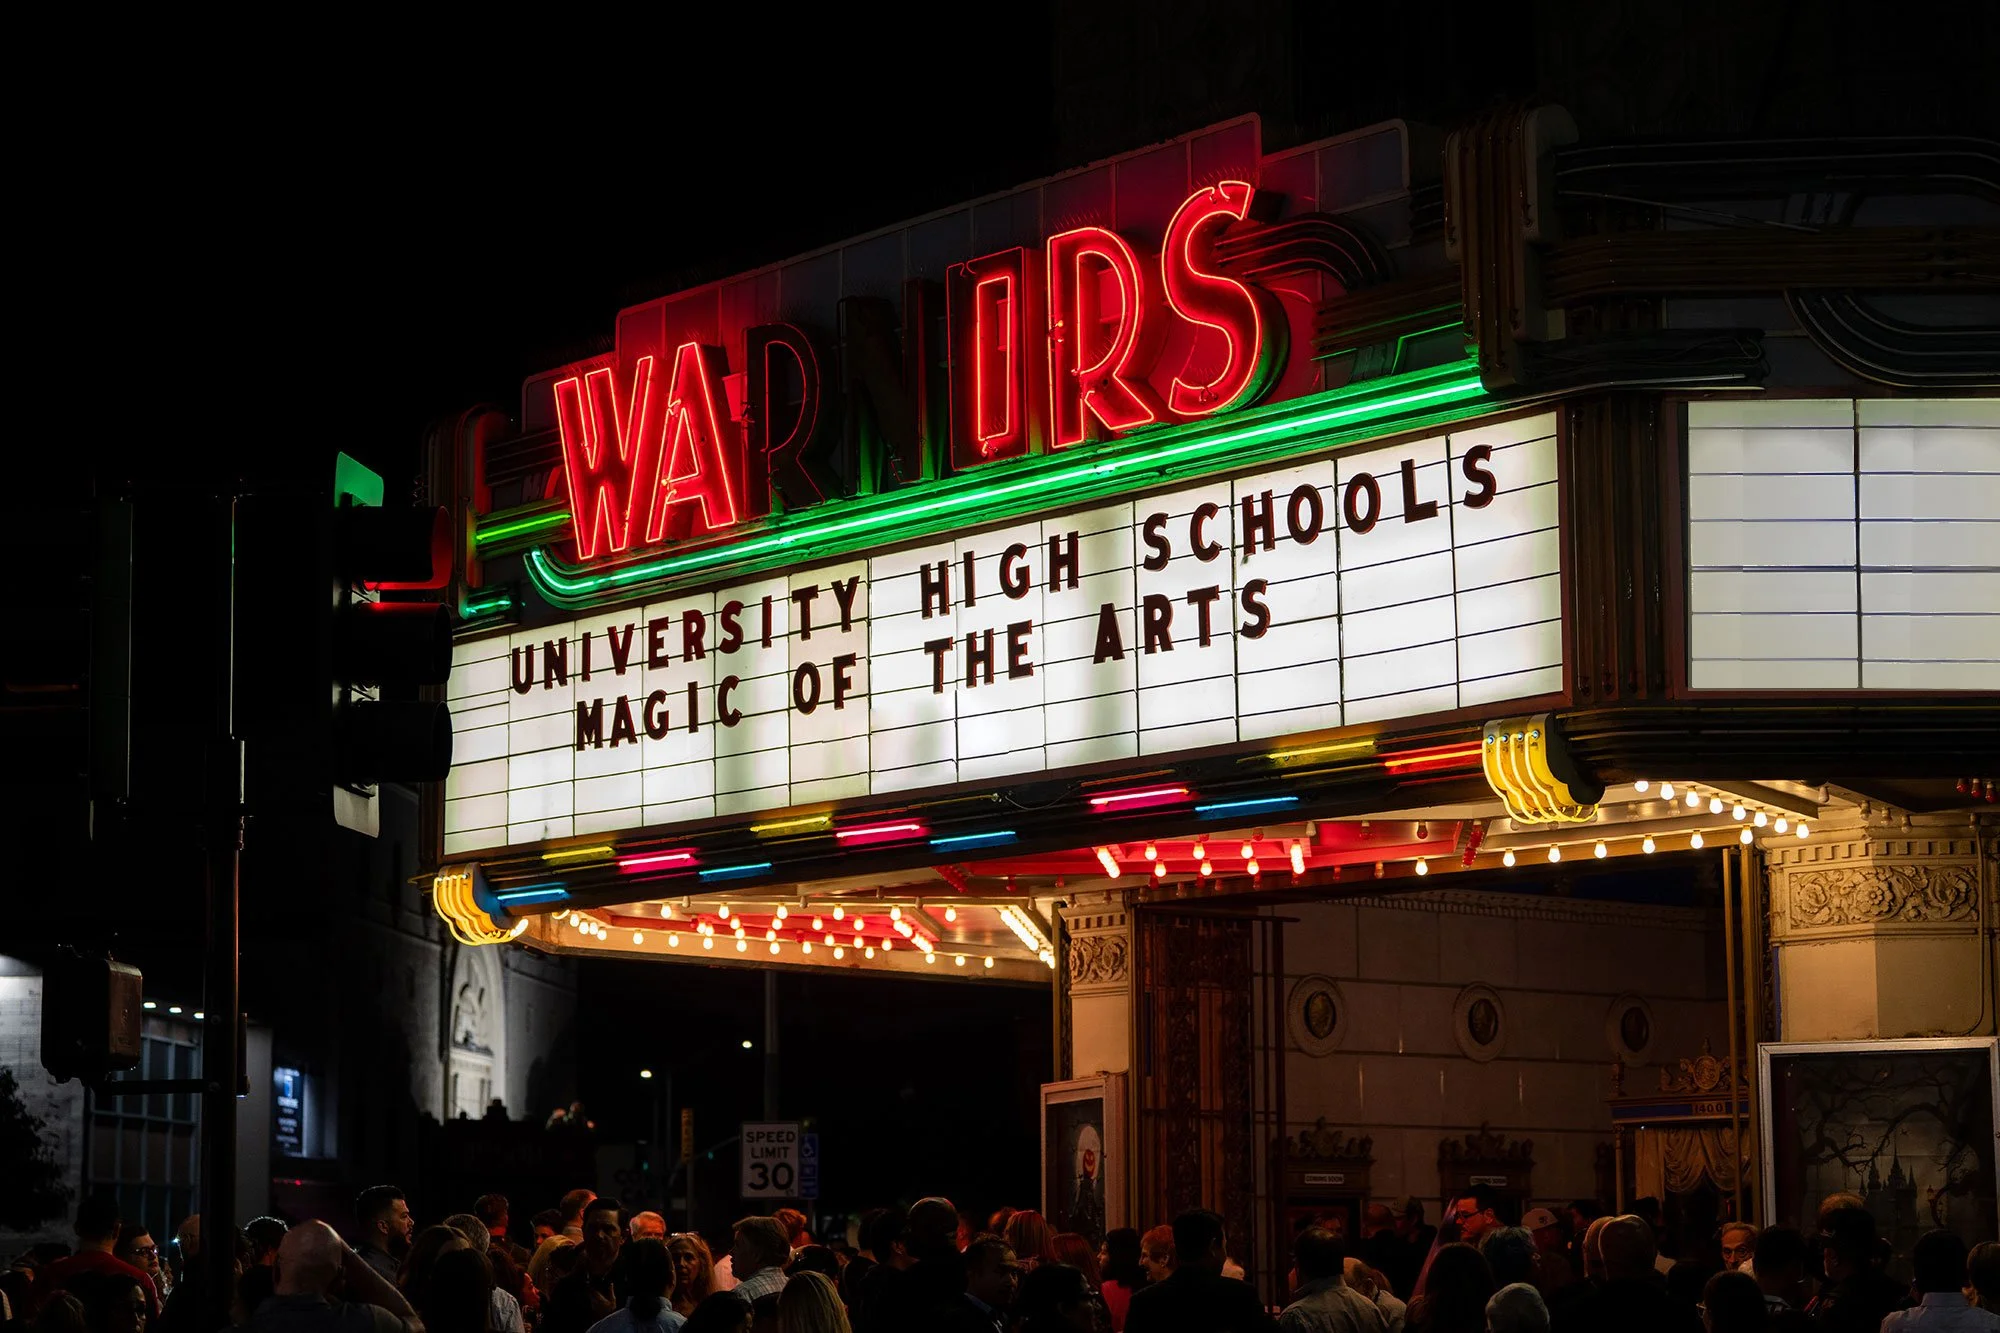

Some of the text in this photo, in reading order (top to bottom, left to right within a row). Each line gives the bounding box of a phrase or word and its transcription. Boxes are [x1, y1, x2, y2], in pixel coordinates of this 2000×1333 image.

[511, 443, 1498, 695] UNIVERSITY HIGH SCHOOLS
[575, 578, 1272, 752] MAGIC OF THE ARTS
[745, 1130, 796, 1144] SPEED
[750, 1146, 791, 1159] LIMIT
[748, 1161, 795, 1191] 30
